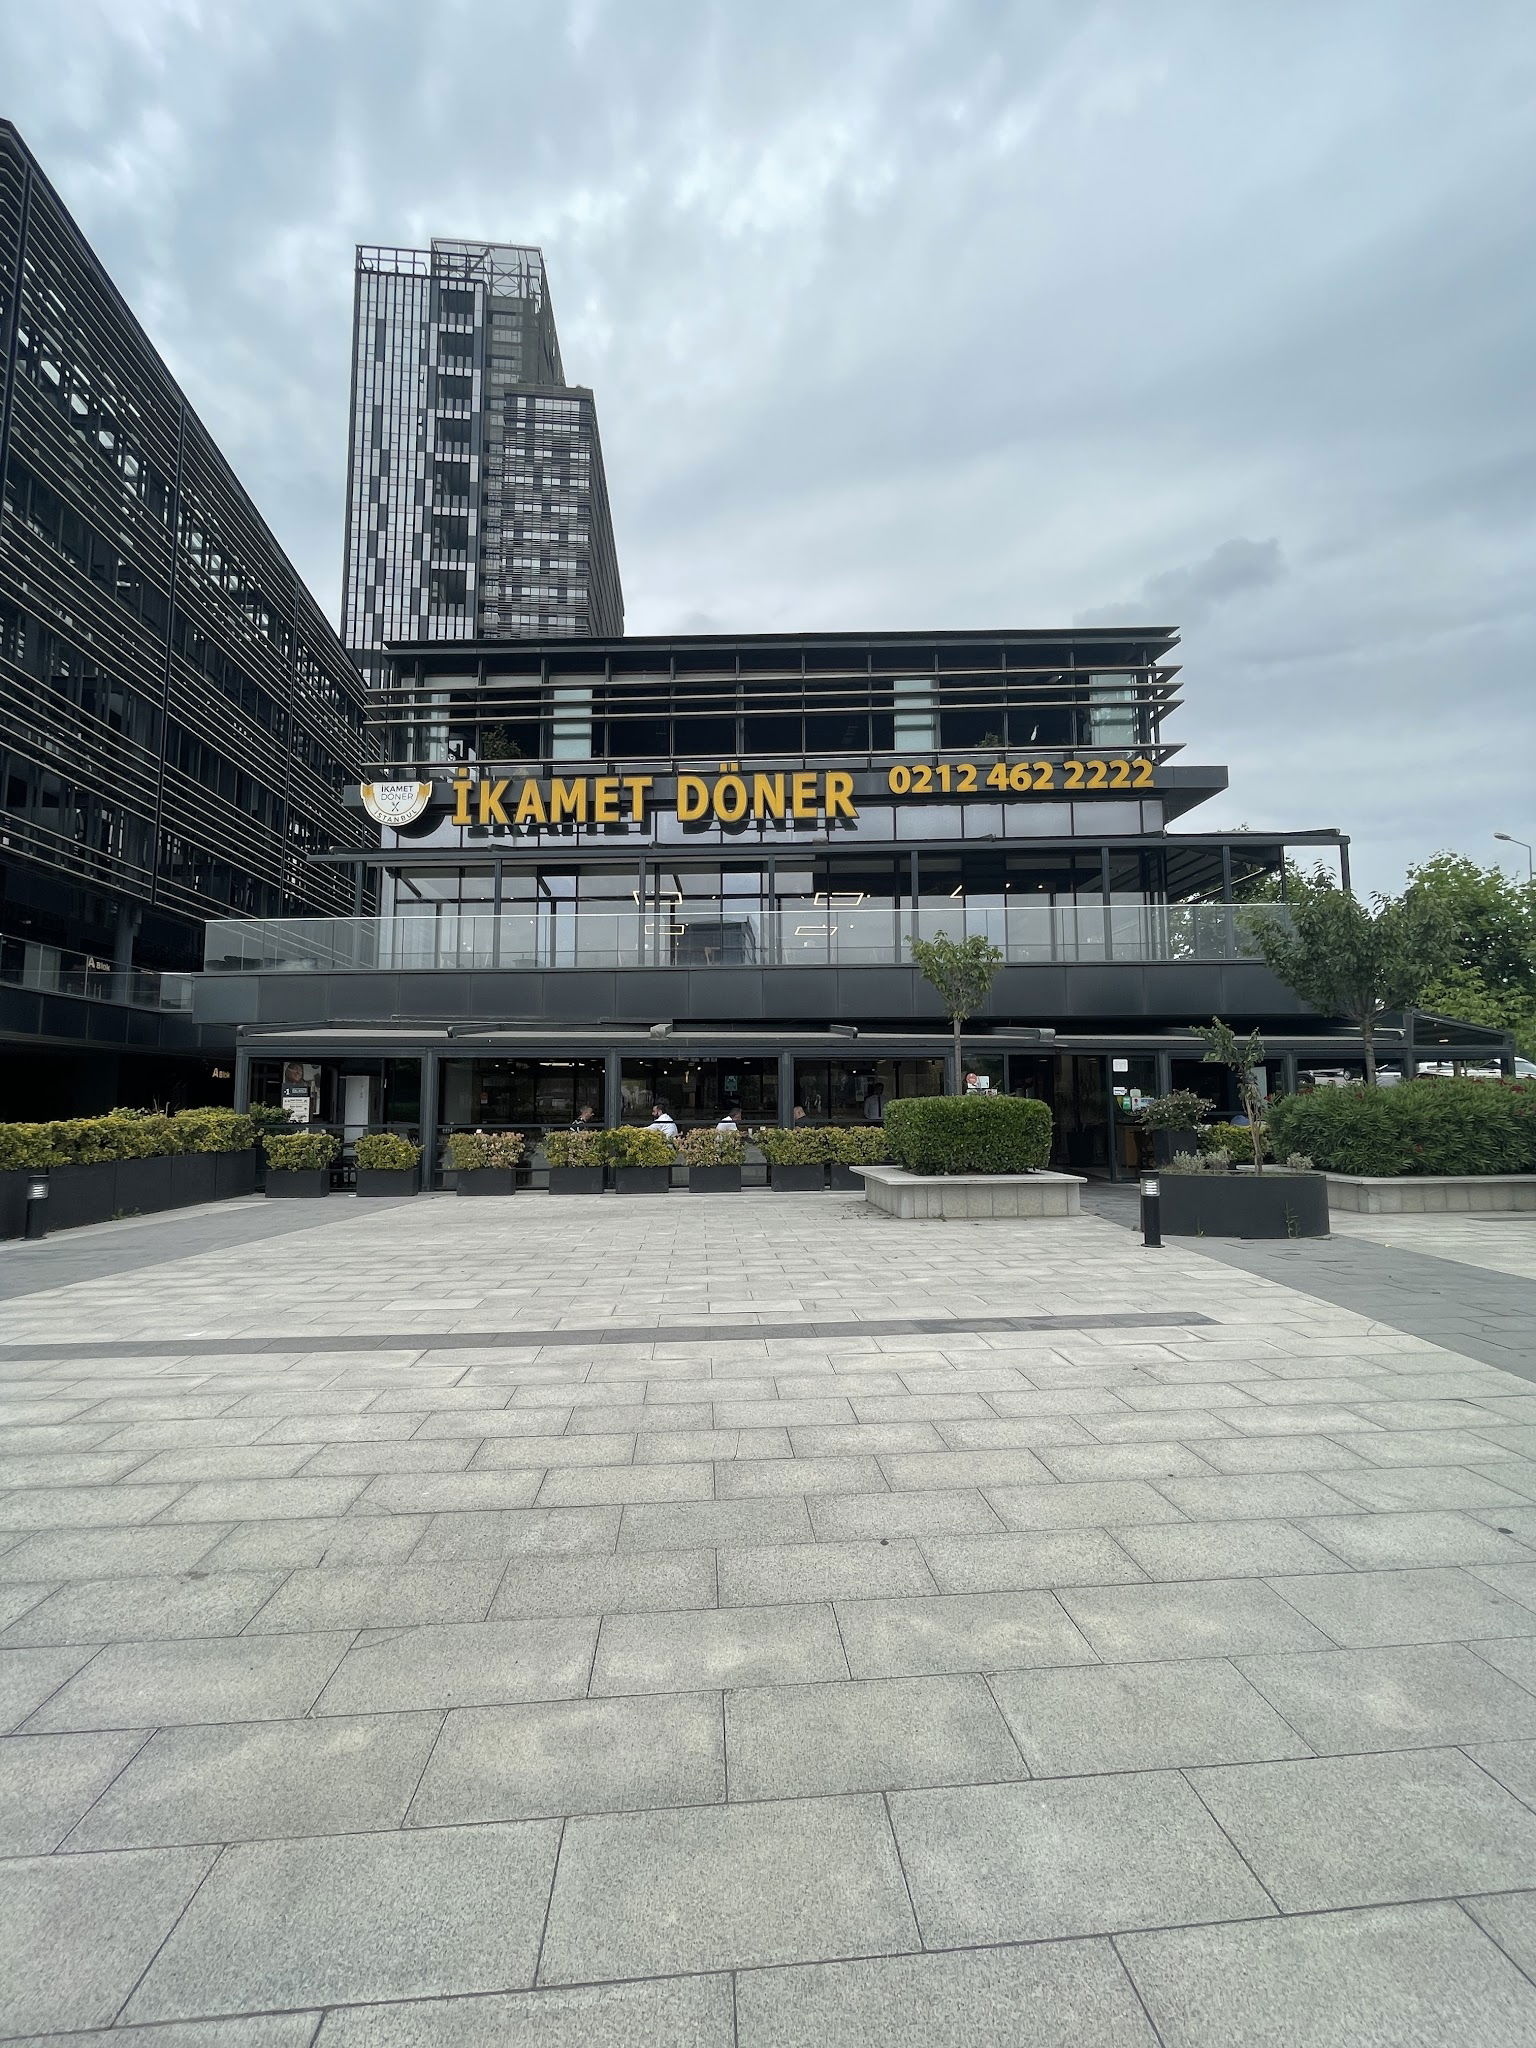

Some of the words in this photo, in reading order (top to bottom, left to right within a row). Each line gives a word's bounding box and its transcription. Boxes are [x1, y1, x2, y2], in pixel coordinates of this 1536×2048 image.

[888, 765, 978, 794] 0212
[986, 762, 1055, 791] 462
[1063, 759, 1154, 789] 2222
[452, 768, 654, 826] İKAMET
[676, 762, 859, 824] DÖNER
[88, 957, 95, 969] A
[212, 1067, 219, 1078] A
